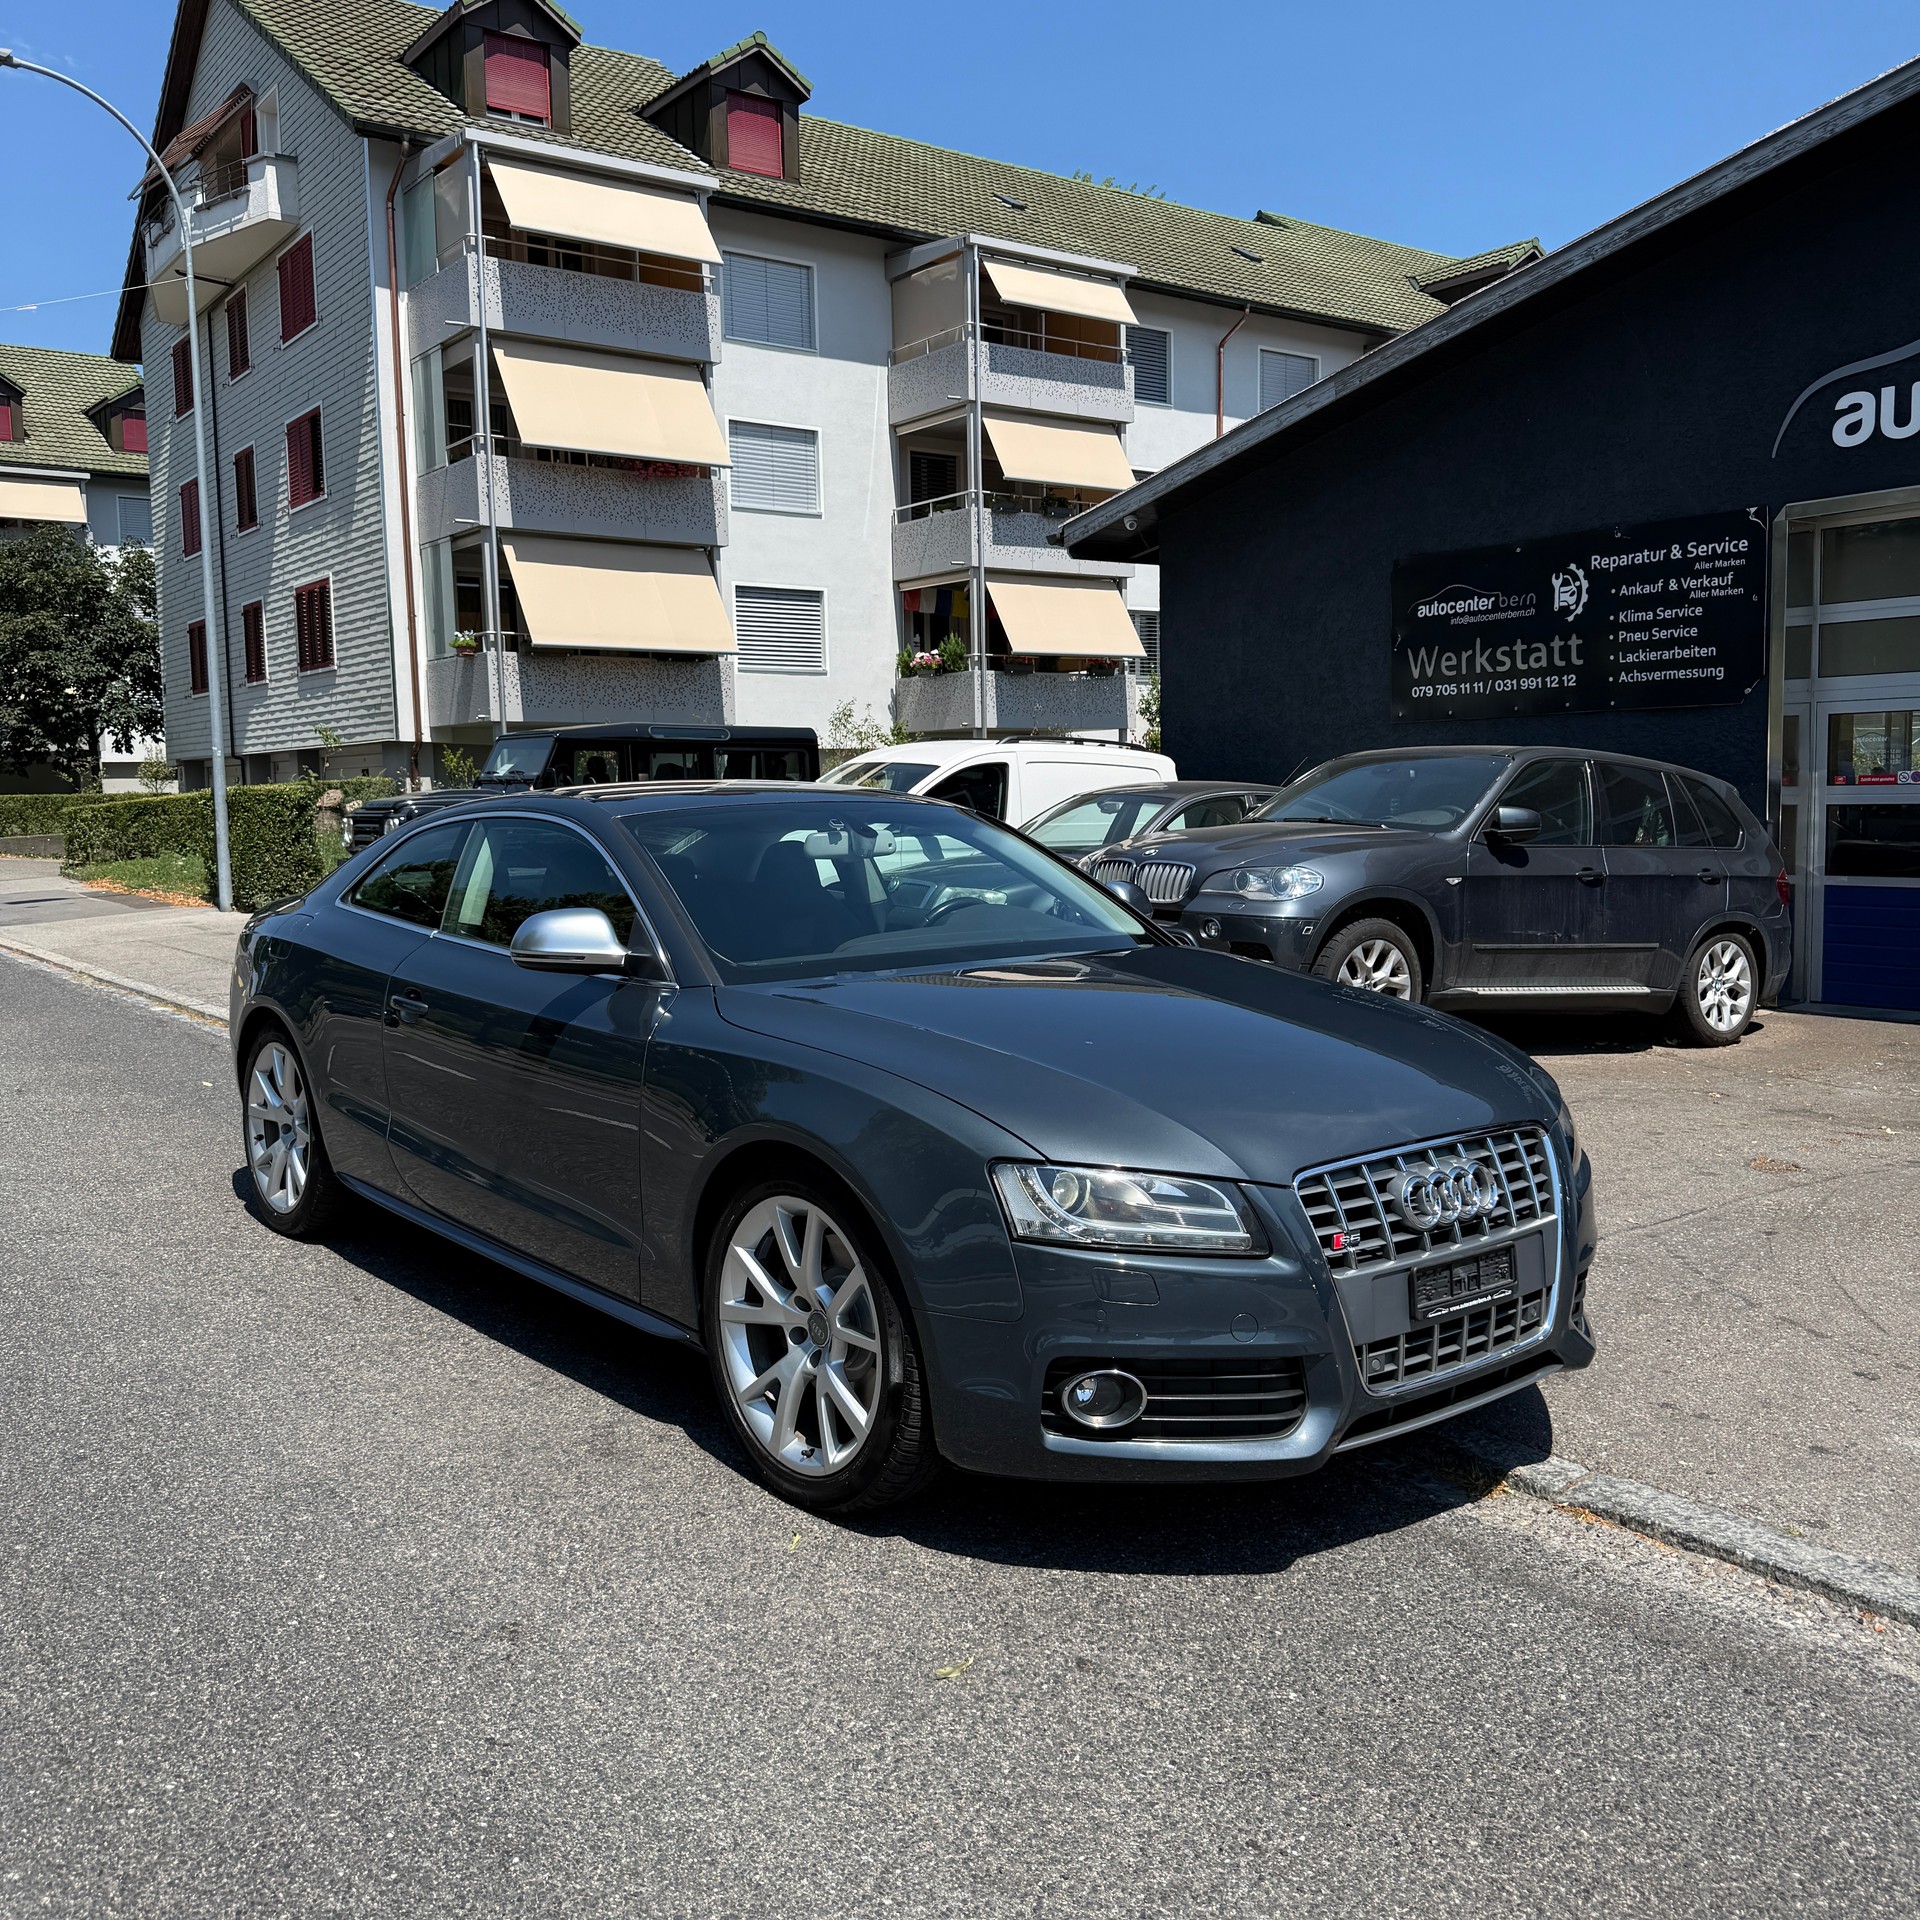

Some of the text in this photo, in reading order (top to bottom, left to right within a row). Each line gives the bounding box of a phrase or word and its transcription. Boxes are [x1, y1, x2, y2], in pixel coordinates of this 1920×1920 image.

[1591, 536, 1749, 572] Reparatur & Service
[1694, 558, 1746, 570] Aller Marken
[1619, 571, 1734, 596] Ankauf & Verkauf
[1689, 586, 1744, 599] Aller Marken
[1417, 592, 1536, 618] autocenter bern
[1619, 604, 1703, 623] Klima Service
[1450, 607, 1536, 625] info@autocenterbern.ch
[1618, 624, 1698, 642] Pneu Service
[1407, 633, 1584, 680] Werkstatt
[1619, 644, 1716, 663] Lackierarbeiten
[1618, 666, 1724, 683] Achsvermessung
[1411, 674, 1577, 698] 079 705 11 11 / 031 991 12 12
